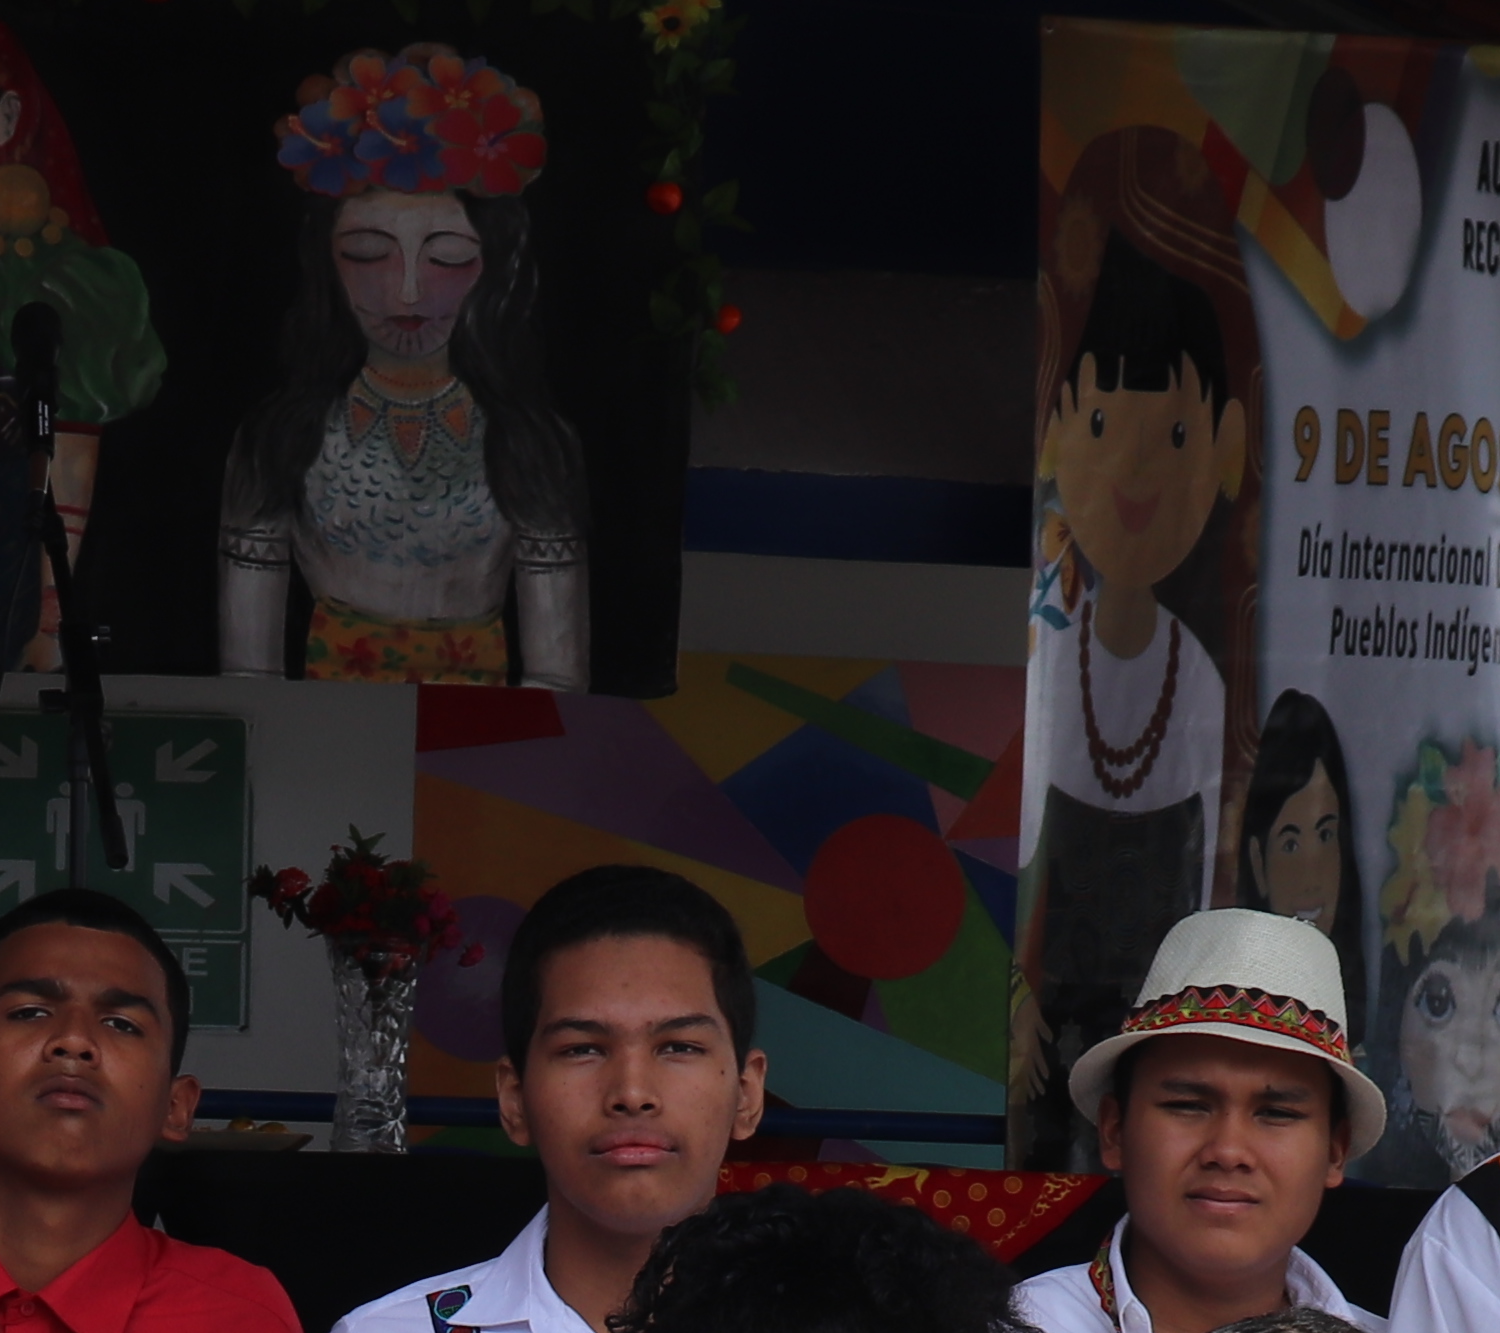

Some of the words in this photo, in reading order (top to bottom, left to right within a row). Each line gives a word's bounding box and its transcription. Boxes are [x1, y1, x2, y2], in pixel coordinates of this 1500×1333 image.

[1293, 405, 1321, 482] 9
[1335, 408, 1390, 486] DE
[1297, 521, 1333, 578] Día
[1338, 531, 1492, 587] Internacional
[1328, 602, 1419, 658] Pueblos
